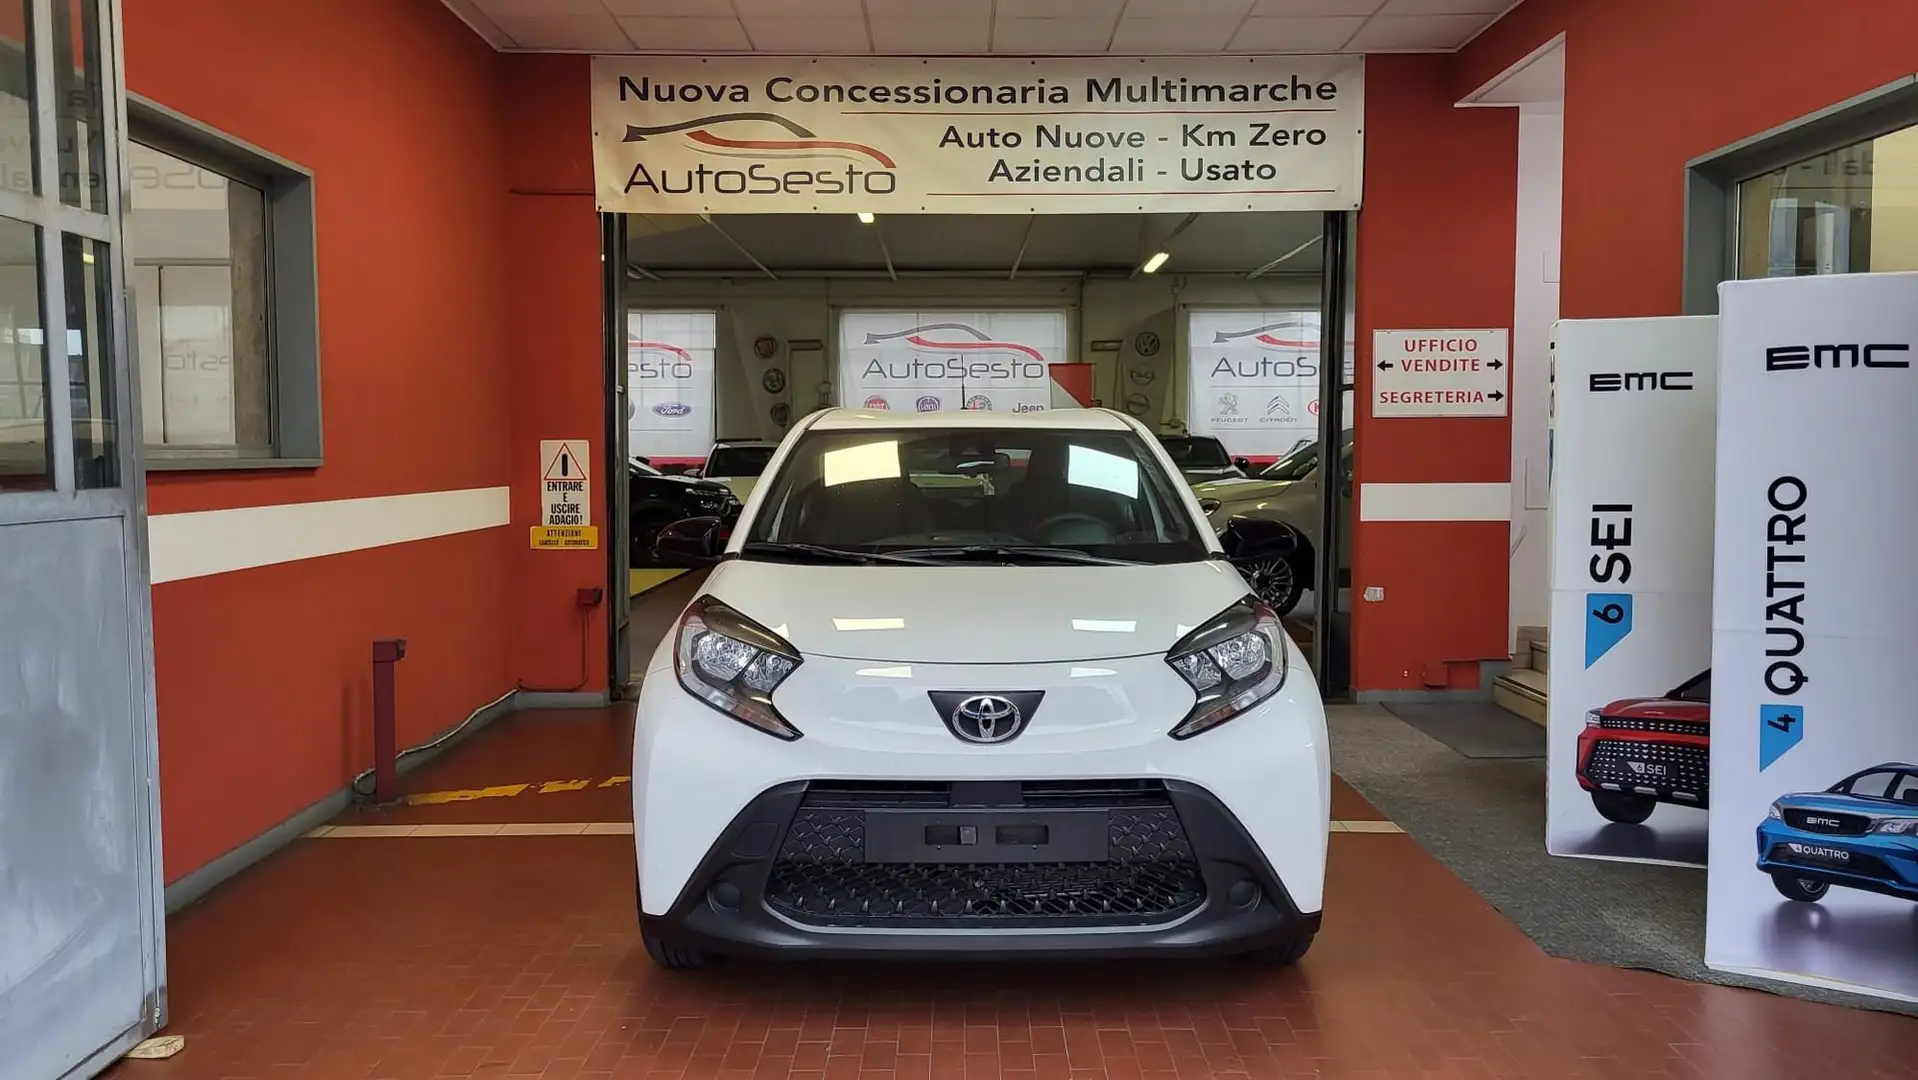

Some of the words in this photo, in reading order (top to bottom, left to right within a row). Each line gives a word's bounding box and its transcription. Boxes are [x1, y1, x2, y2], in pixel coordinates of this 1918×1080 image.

[618, 76, 750, 103] Nuova
[764, 76, 1069, 105] Concessionaria
[1085, 74, 1338, 104] Multimarche
[938, 125, 1022, 149] Auto
[1035, 124, 1146, 149] Nuove
[1181, 123, 1236, 147] Km
[1248, 123, 1327, 147] Zero
[623, 163, 896, 195] AutoSesto
[987, 158, 1144, 183] Aziendali
[1180, 157, 1278, 182] Usato
[1404, 339, 1478, 352] UFFICIO
[1401, 359, 1481, 372] VENDITE
[1766, 344, 1910, 371] EMC
[861, 358, 1045, 379] AutoSesto
[1589, 371, 1693, 392] EMC
[1379, 391, 1484, 404] SEGRETERIA
[547, 481, 584, 492] ENTRARE
[562, 492, 568, 503] E
[550, 503, 581, 514] USCIRE
[548, 514, 583, 525] ADAGIO!
[1590, 504, 1633, 584] SEI
[1764, 476, 1808, 696] QUATTRO
[1592, 603, 1624, 624] 6
[1767, 714, 1796, 733] 4
[1646, 764, 1667, 776] SEI
[1806, 816, 1840, 828] EMC
[1803, 845, 1849, 860] QUATTRO
